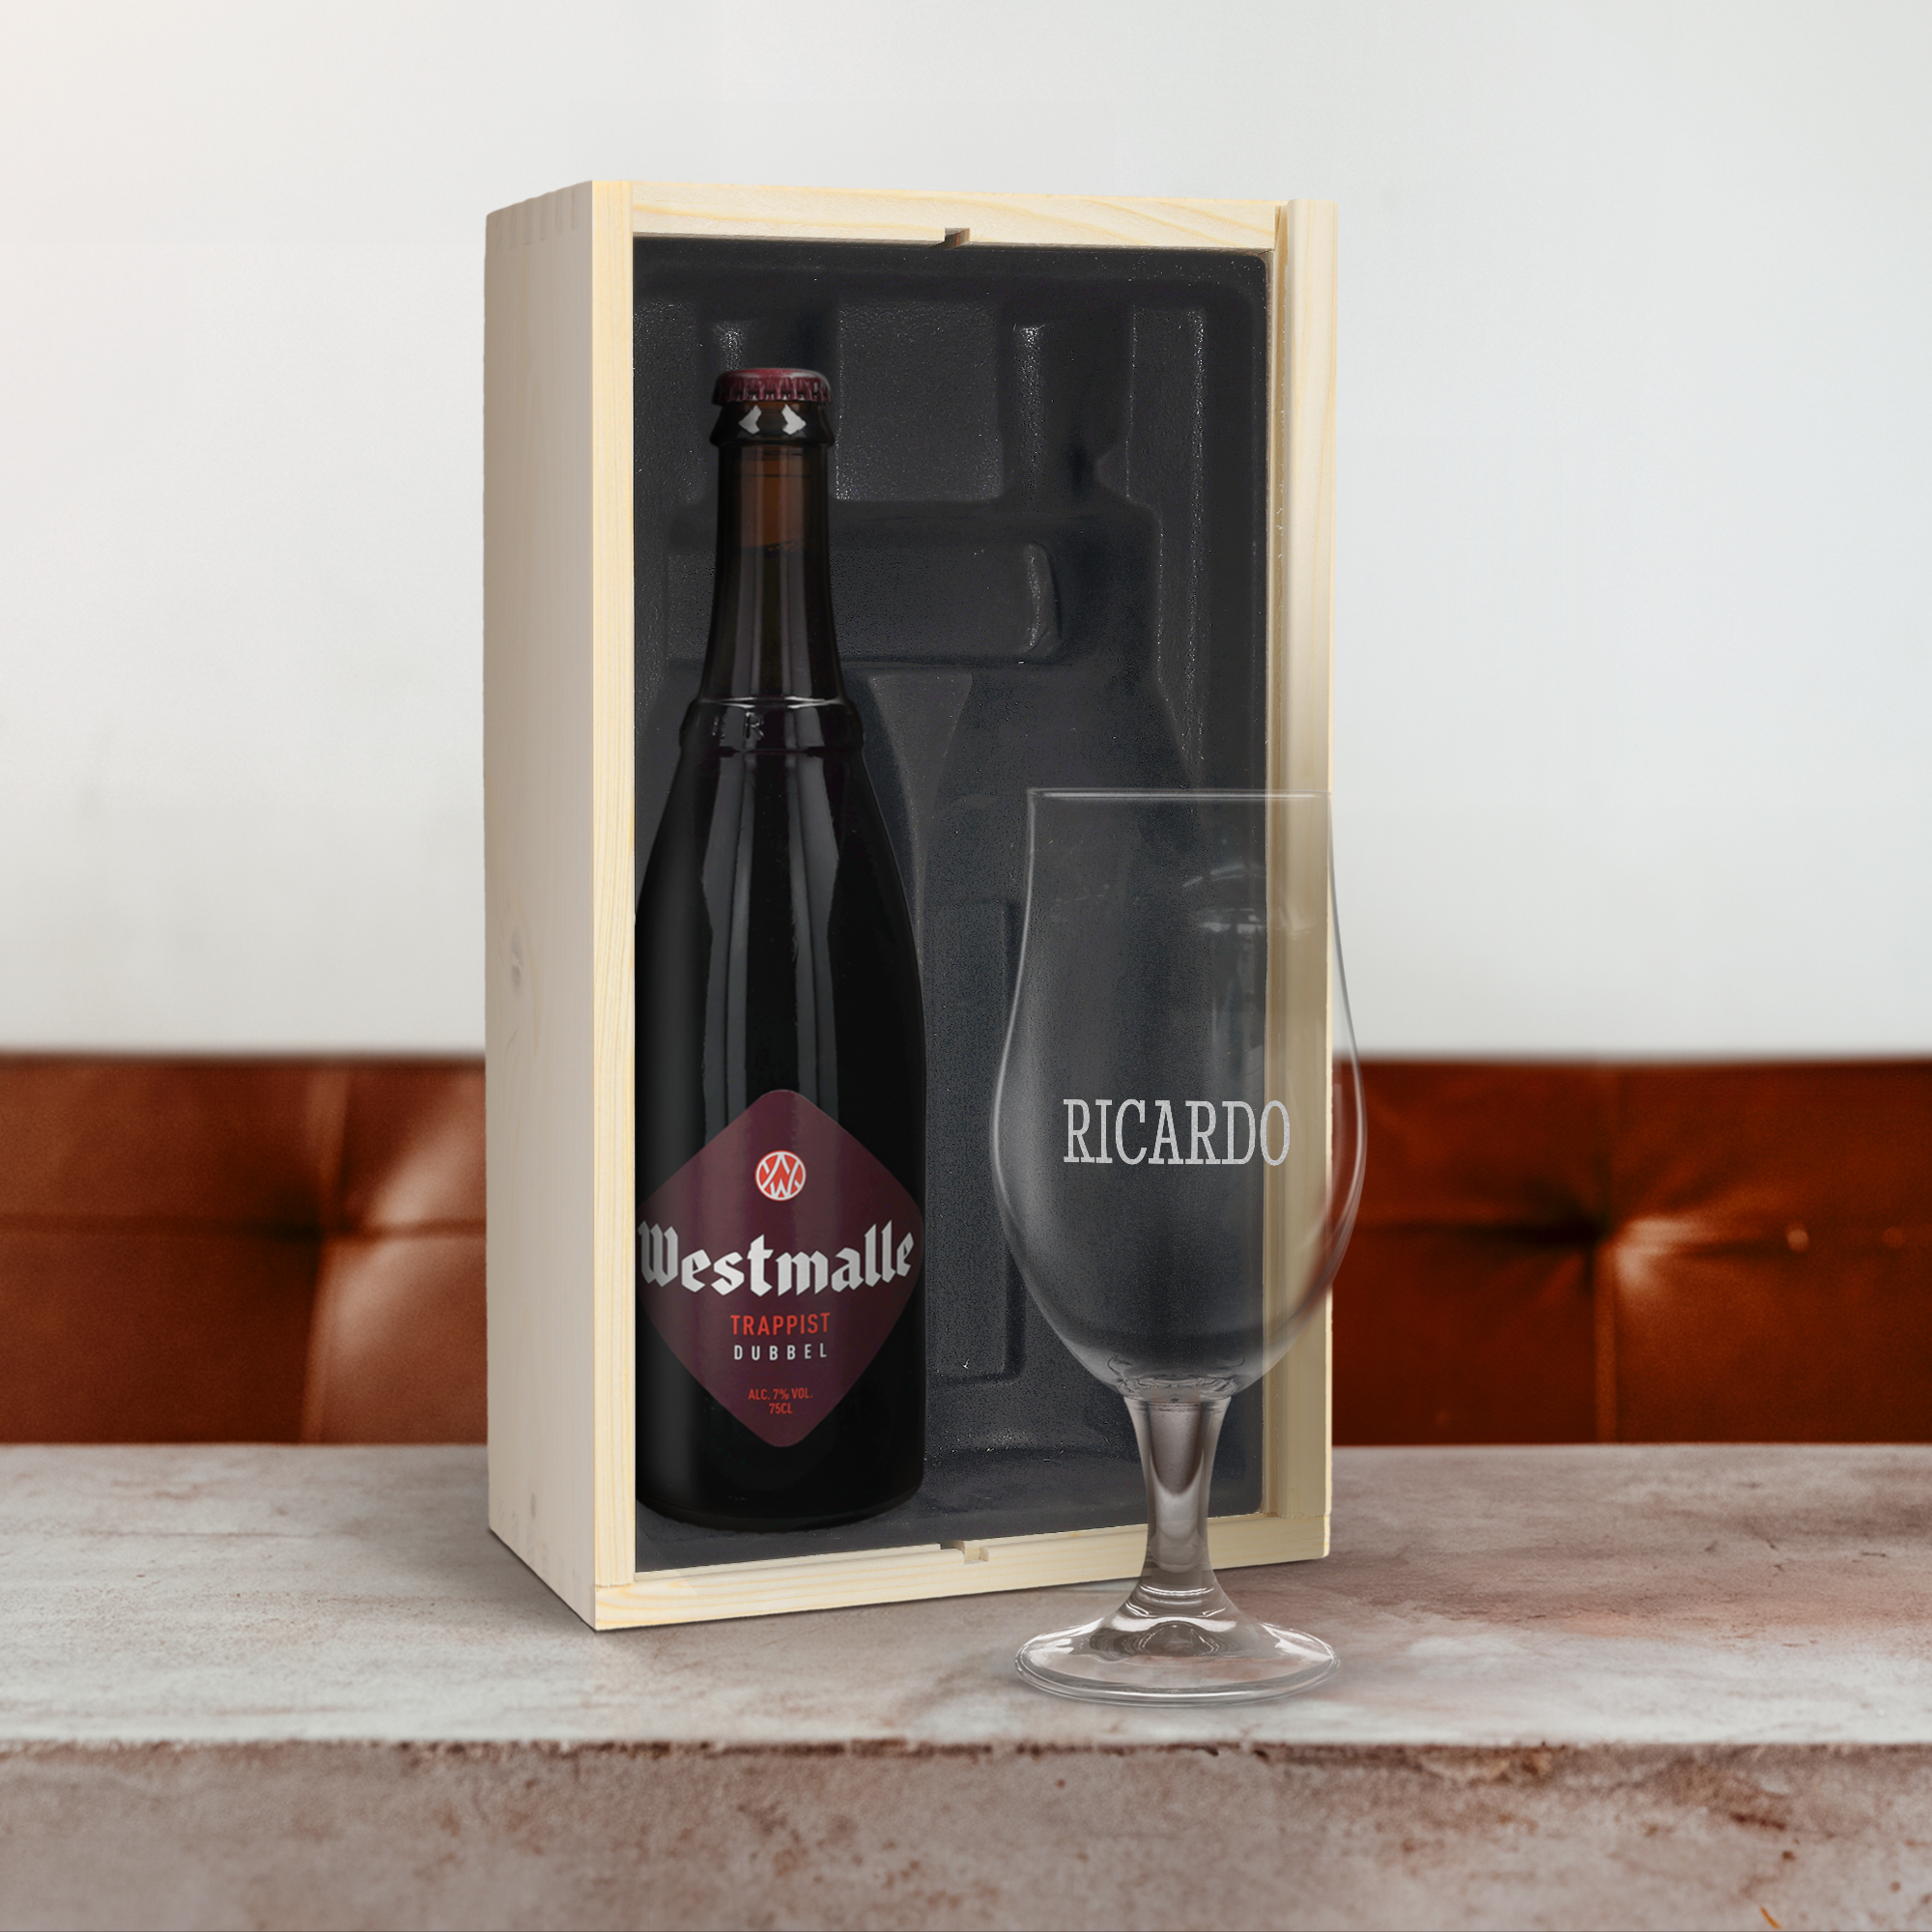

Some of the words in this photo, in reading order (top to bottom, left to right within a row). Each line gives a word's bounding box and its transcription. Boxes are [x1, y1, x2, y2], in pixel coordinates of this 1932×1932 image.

[1063, 1098, 1291, 1166] RICARDO
[637, 1219, 915, 1297] Westmalle
[730, 1312, 831, 1336] TRAPPIST
[733, 1342, 827, 1361] DUBBEL
[748, 1388, 771, 1401] ALC.
[773, 1388, 789, 1400] 7%
[791, 1387, 813, 1400] VOL.
[769, 1403, 793, 1414] 75CL
